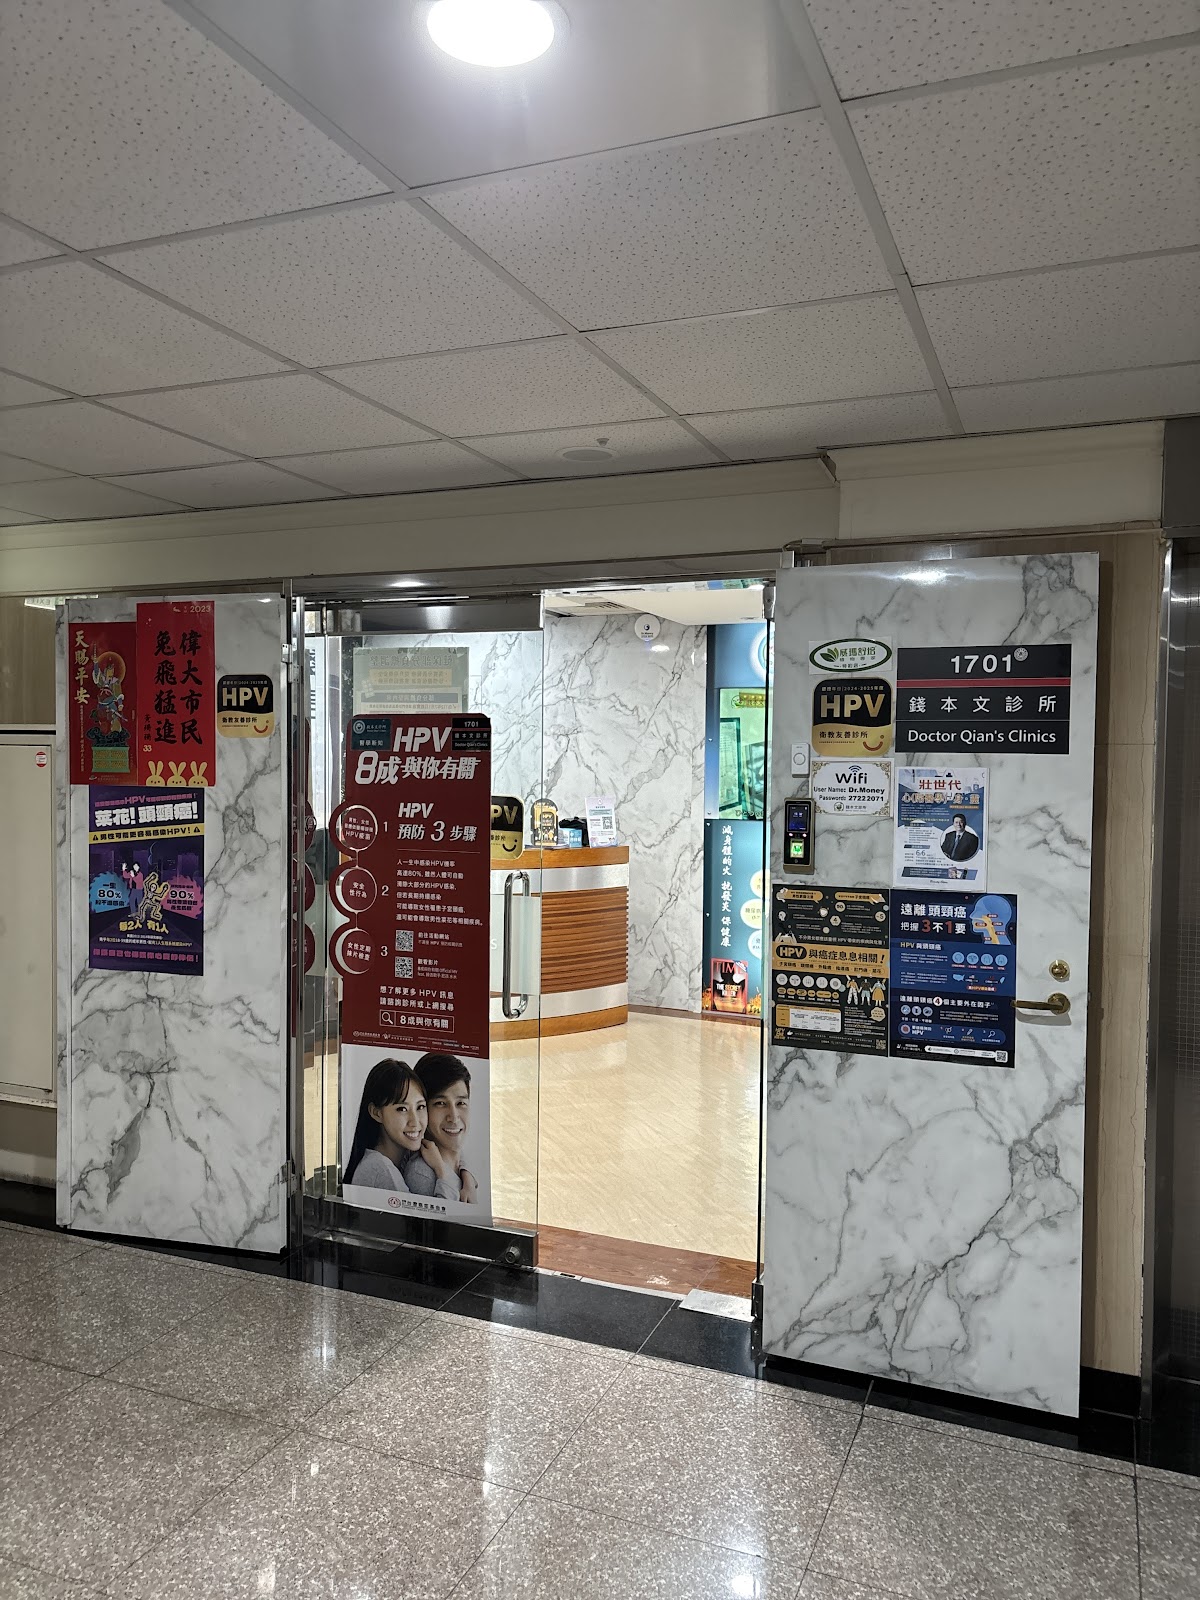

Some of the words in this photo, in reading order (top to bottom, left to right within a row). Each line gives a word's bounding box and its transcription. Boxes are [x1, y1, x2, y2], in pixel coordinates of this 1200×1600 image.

[190, 605, 211, 613] 2023
[73, 630, 90, 705] 天賜平安
[951, 654, 1012, 674] 1701
[154, 630, 177, 744] 兔飛猛進
[179, 630, 202, 744] 偉大市民
[222, 687, 269, 706] HPV
[821, 694, 886, 718] HPV
[909, 696, 1057, 714] 錢本文診所
[393, 727, 452, 752] HPV
[908, 730, 958, 743] Doctor
[960, 729, 1004, 744] Qian's
[1008, 729, 1056, 743] Clinics
[355, 751, 481, 785] 8成與你有關
[836, 772, 868, 784] Wifi
[919, 780, 962, 790] 壯世代
[848, 787, 886, 795] Dr.Money
[398, 803, 434, 818] HPV
[491, 804, 518, 824] PV
[384, 822, 388, 832] 1
[397, 824, 426, 840] 預防
[430, 820, 446, 842] 3
[450, 825, 478, 842] 步驟
[352, 882, 365, 890] 安全
[382, 886, 390, 896] 2
[98, 890, 122, 898] 80%
[170, 890, 194, 899] 90%
[900, 903, 966, 918] 遠離頭頸癌
[380, 946, 388, 956] 3
[780, 946, 804, 958] HPV
[380, 986, 416, 996] 想了解更多
[419, 990, 437, 998] HPV
[400, 1016, 449, 1028] 8成與你有關
